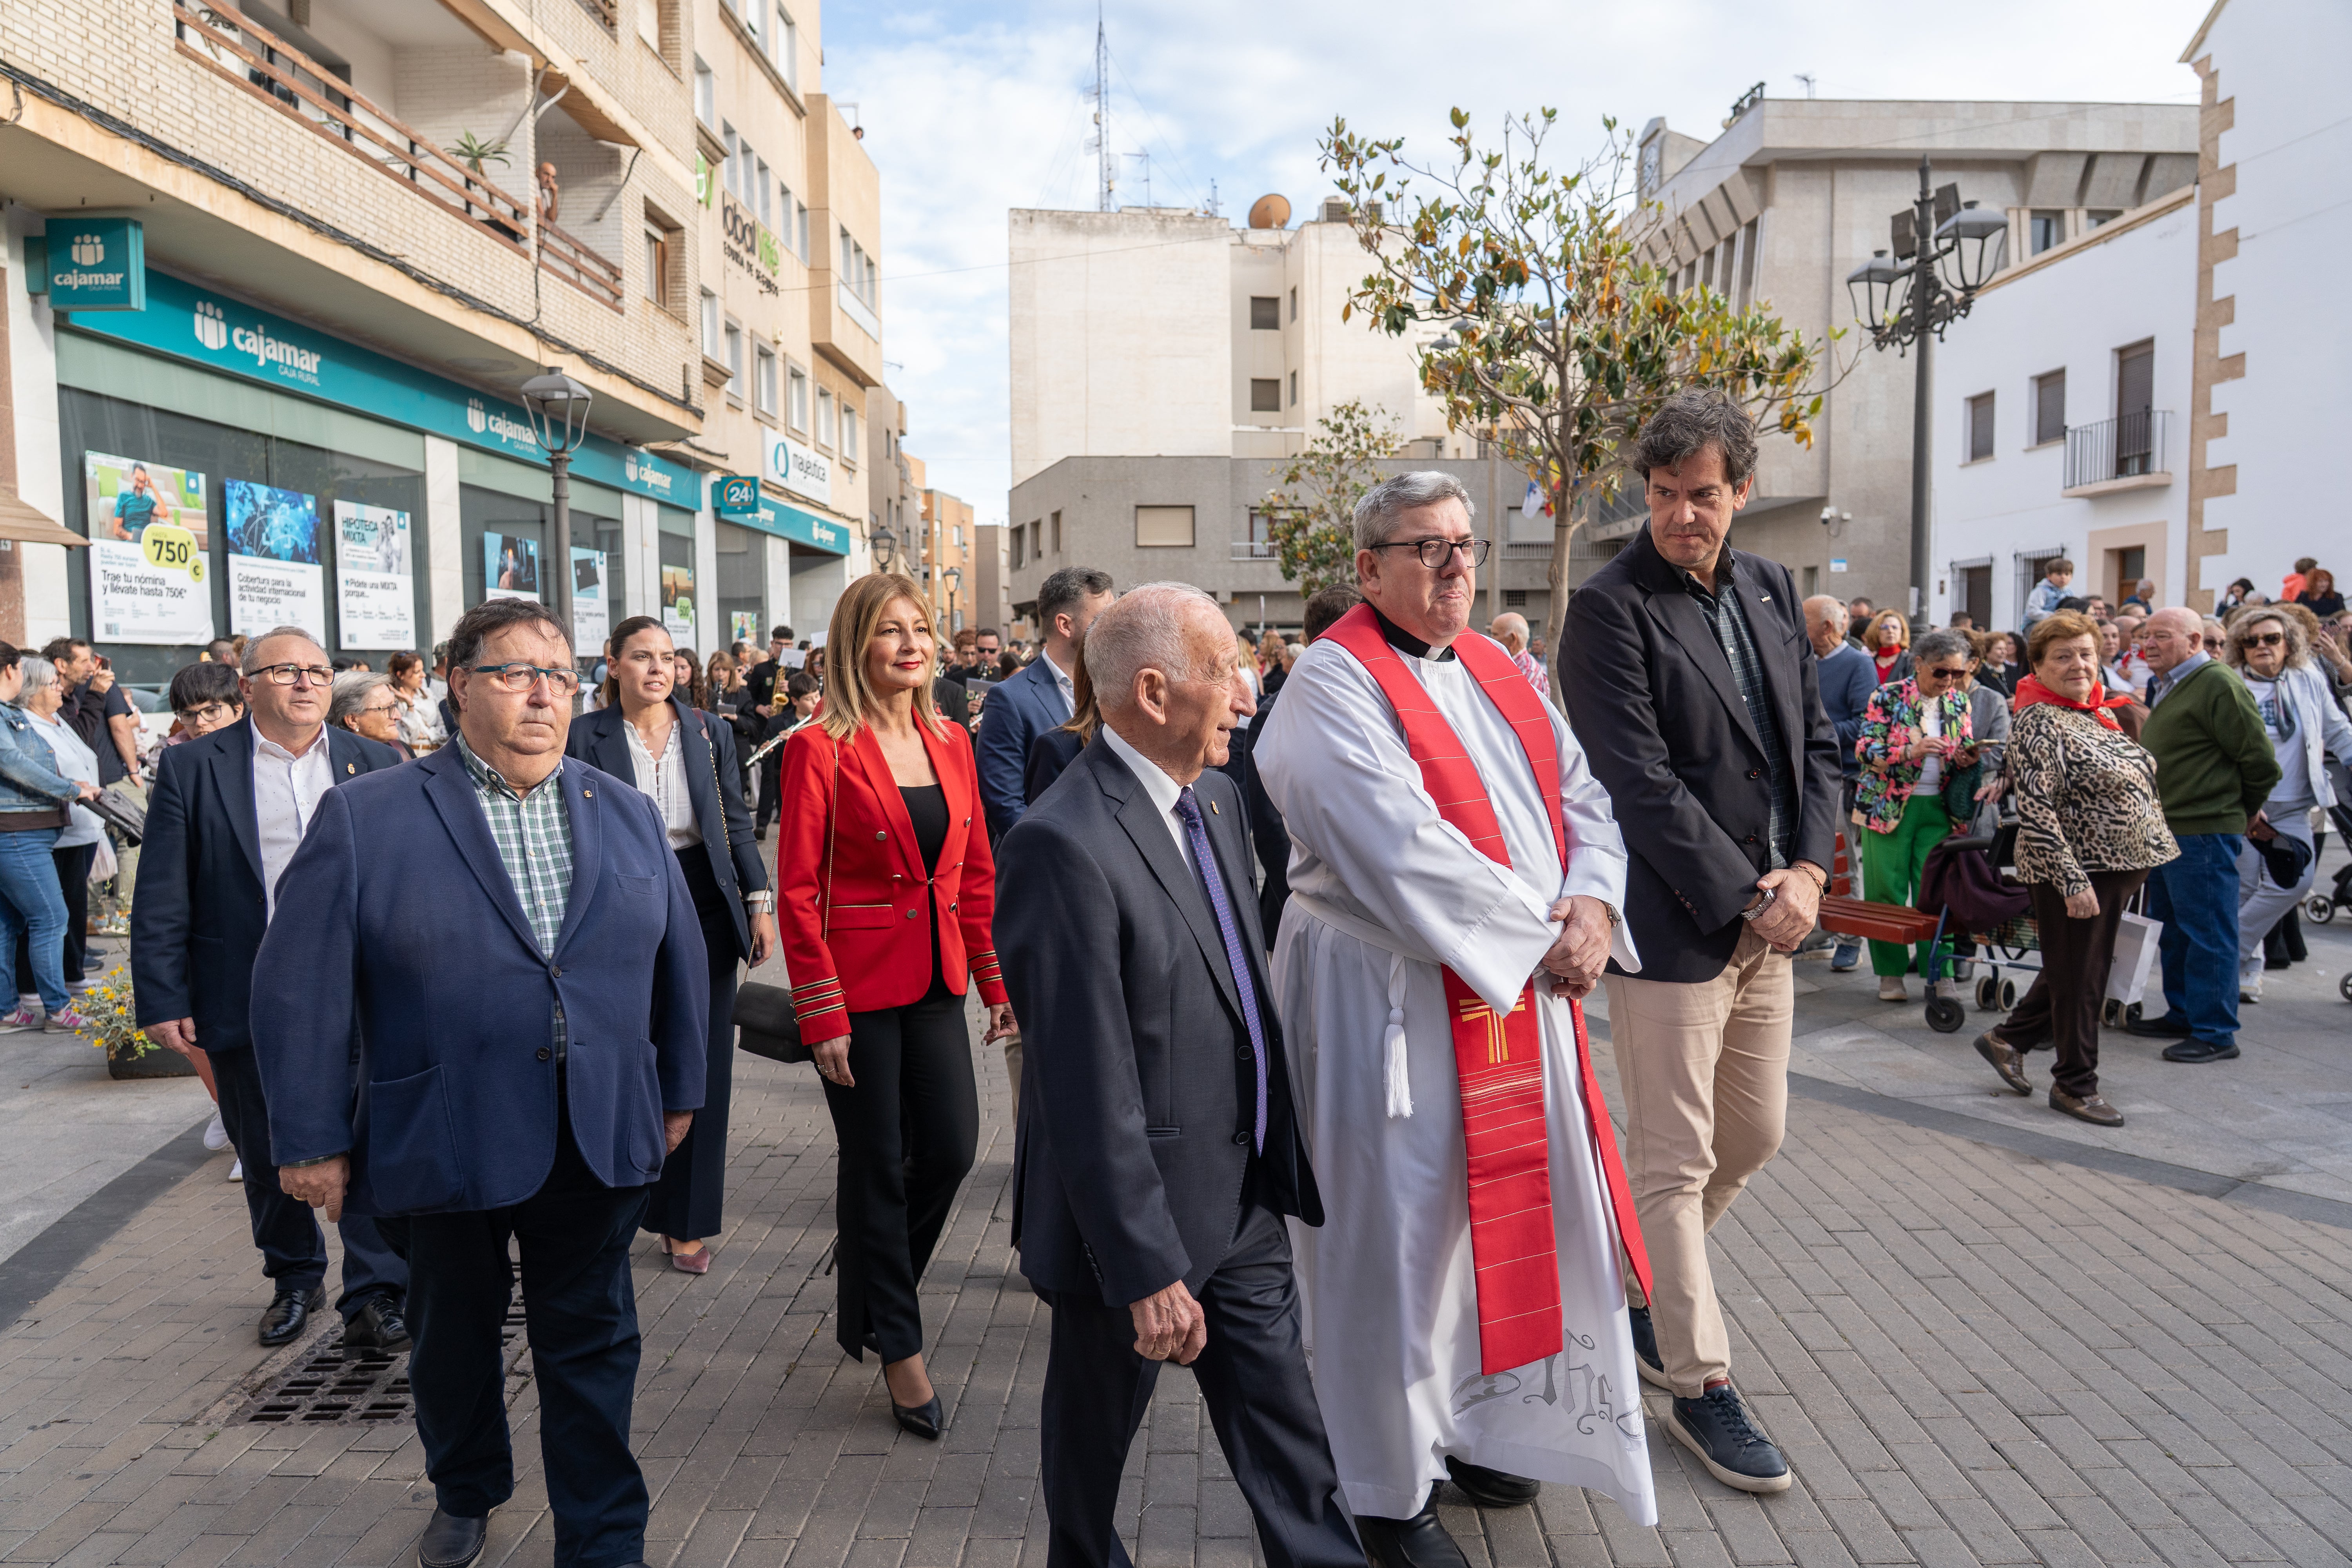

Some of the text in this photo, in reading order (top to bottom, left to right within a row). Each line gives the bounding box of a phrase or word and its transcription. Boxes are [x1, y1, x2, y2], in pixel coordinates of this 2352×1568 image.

[54, 269, 124, 290] cajamar
[232, 324, 321, 374] cajamar
[278, 364, 321, 387] CAJA RURAL
[488, 412, 539, 445] cajamar
[639, 463, 672, 489] cajamar
[341, 516, 378, 532] HIPOTECA
[342, 531, 367, 543] MIXTA
[102, 569, 166, 586] Trae tu nómina
[238, 572, 270, 584] Cobertura
[286, 577, 292, 587] la
[102, 584, 109, 595] y
[110, 582, 138, 594] llévate
[140, 585, 163, 597] hasta
[238, 583, 307, 598] actividad internacional
[239, 593, 281, 605] de tu negocio
